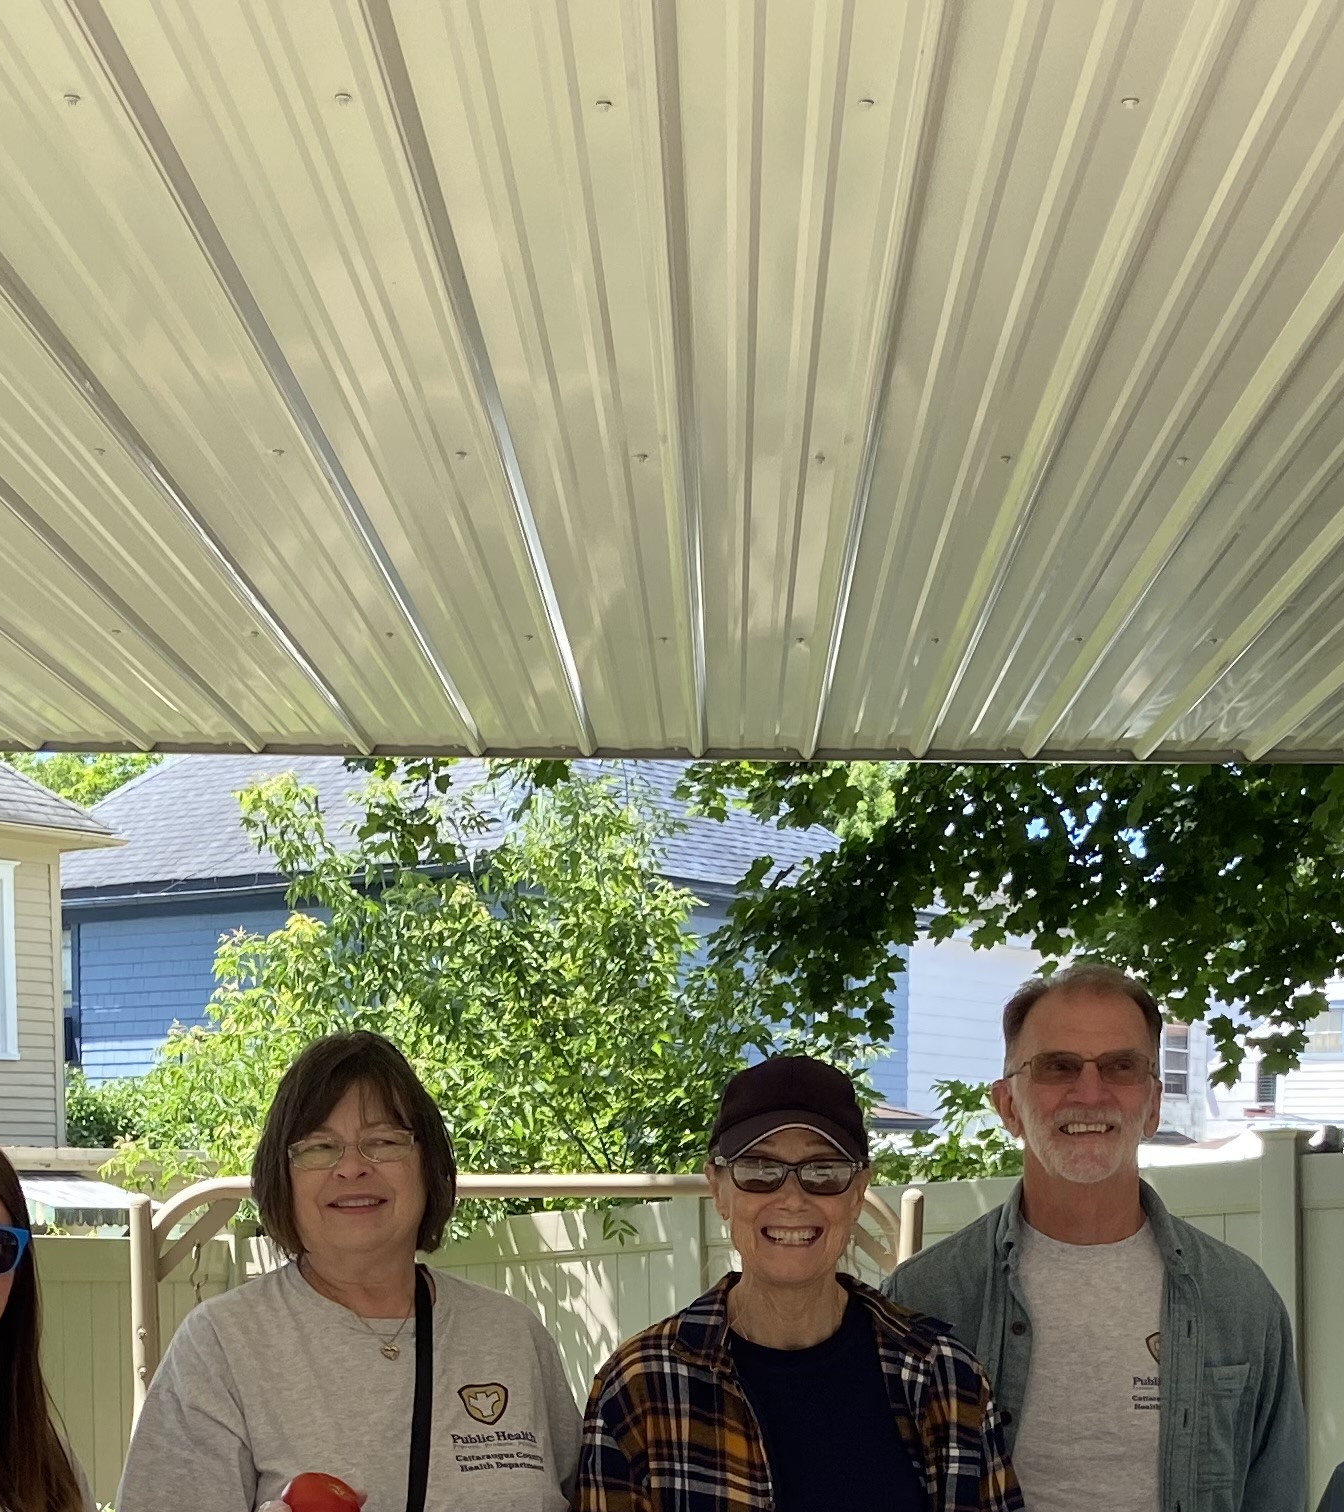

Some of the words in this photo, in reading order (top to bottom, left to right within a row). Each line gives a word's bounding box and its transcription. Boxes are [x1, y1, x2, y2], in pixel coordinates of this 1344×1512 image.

[1132, 1376, 1162, 1386] Publi
[450, 1432, 496, 1445] Public
[494, 1430, 538, 1444] Health
[459, 1461, 494, 1473] Health
